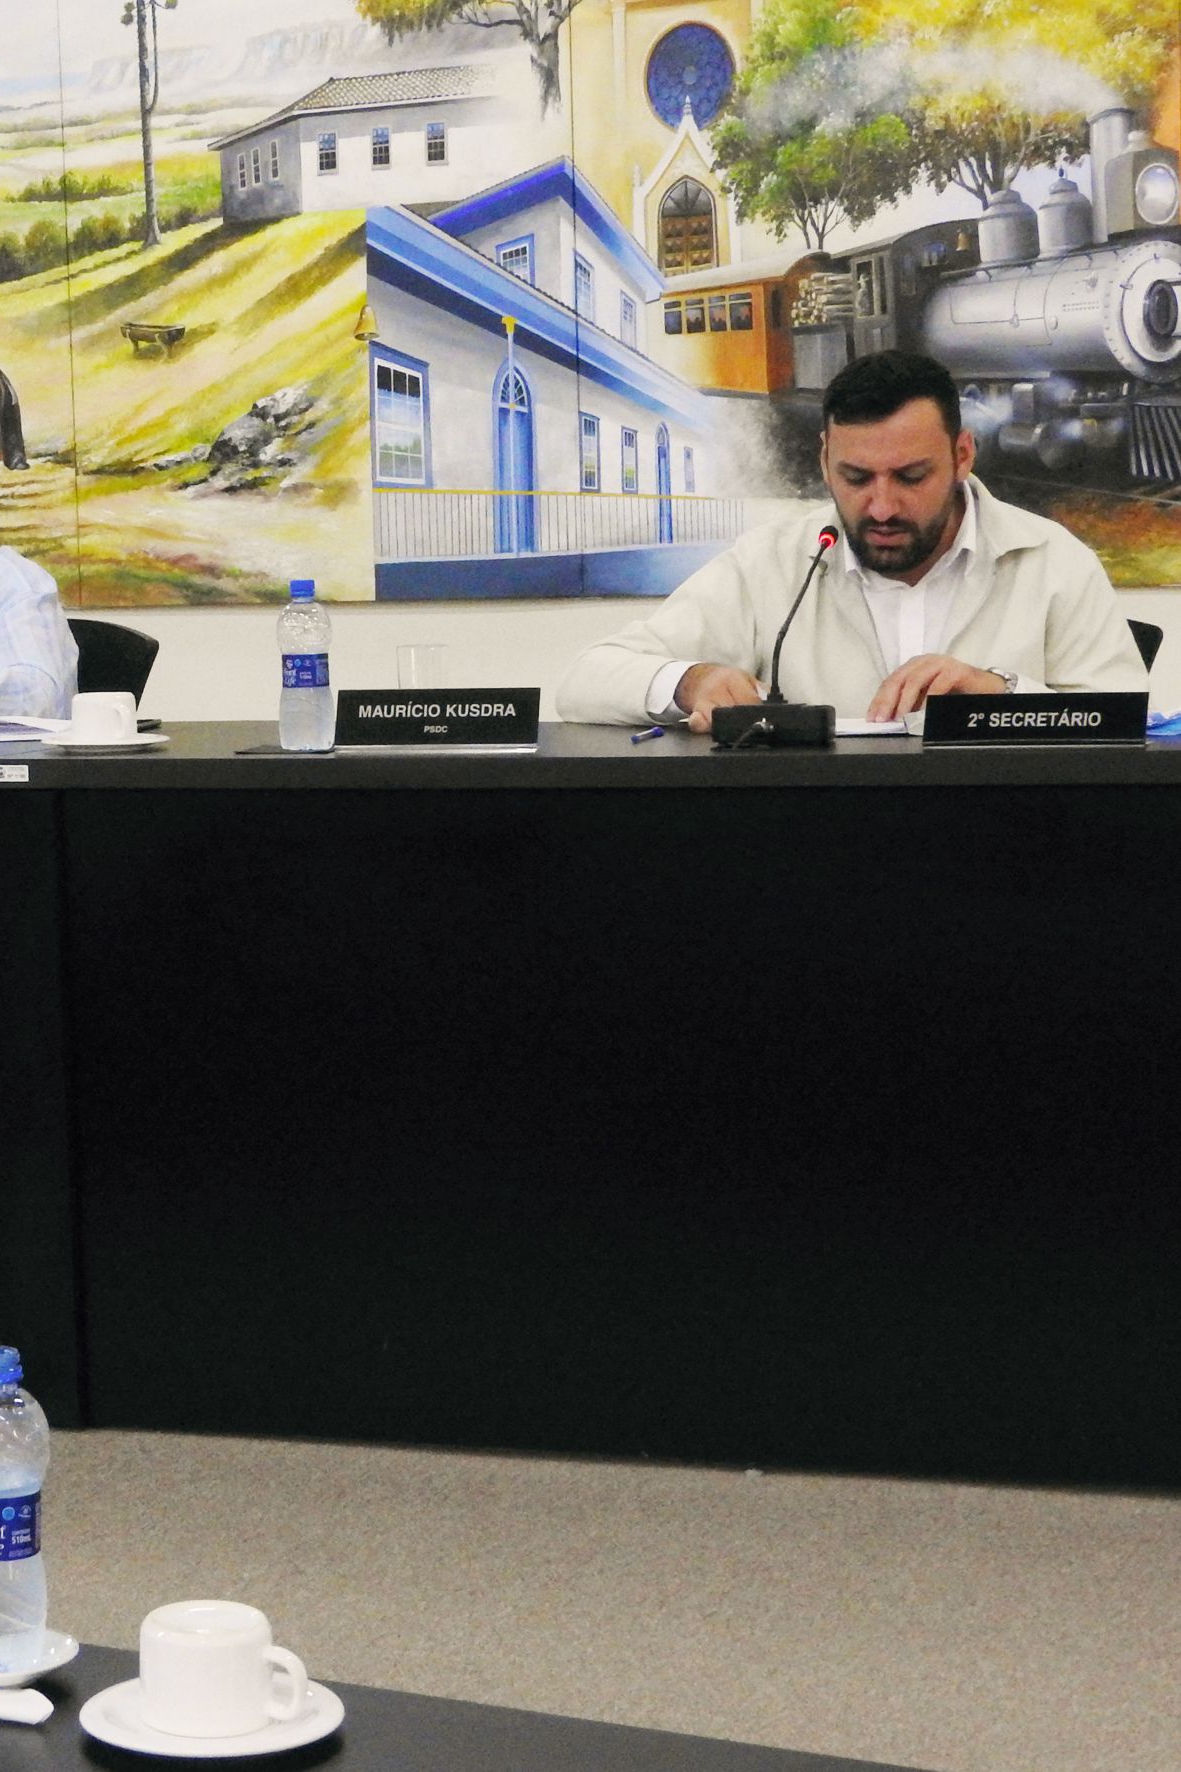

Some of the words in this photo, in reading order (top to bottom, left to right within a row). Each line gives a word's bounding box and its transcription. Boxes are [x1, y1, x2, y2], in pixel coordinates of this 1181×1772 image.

[358, 700, 441, 718] MAURÍCIO
[445, 703, 516, 718] KUSDRA
[967, 712, 985, 728] 2º
[988, 708, 1102, 728] SECRETÁRIO
[423, 725, 448, 734] PSDC
